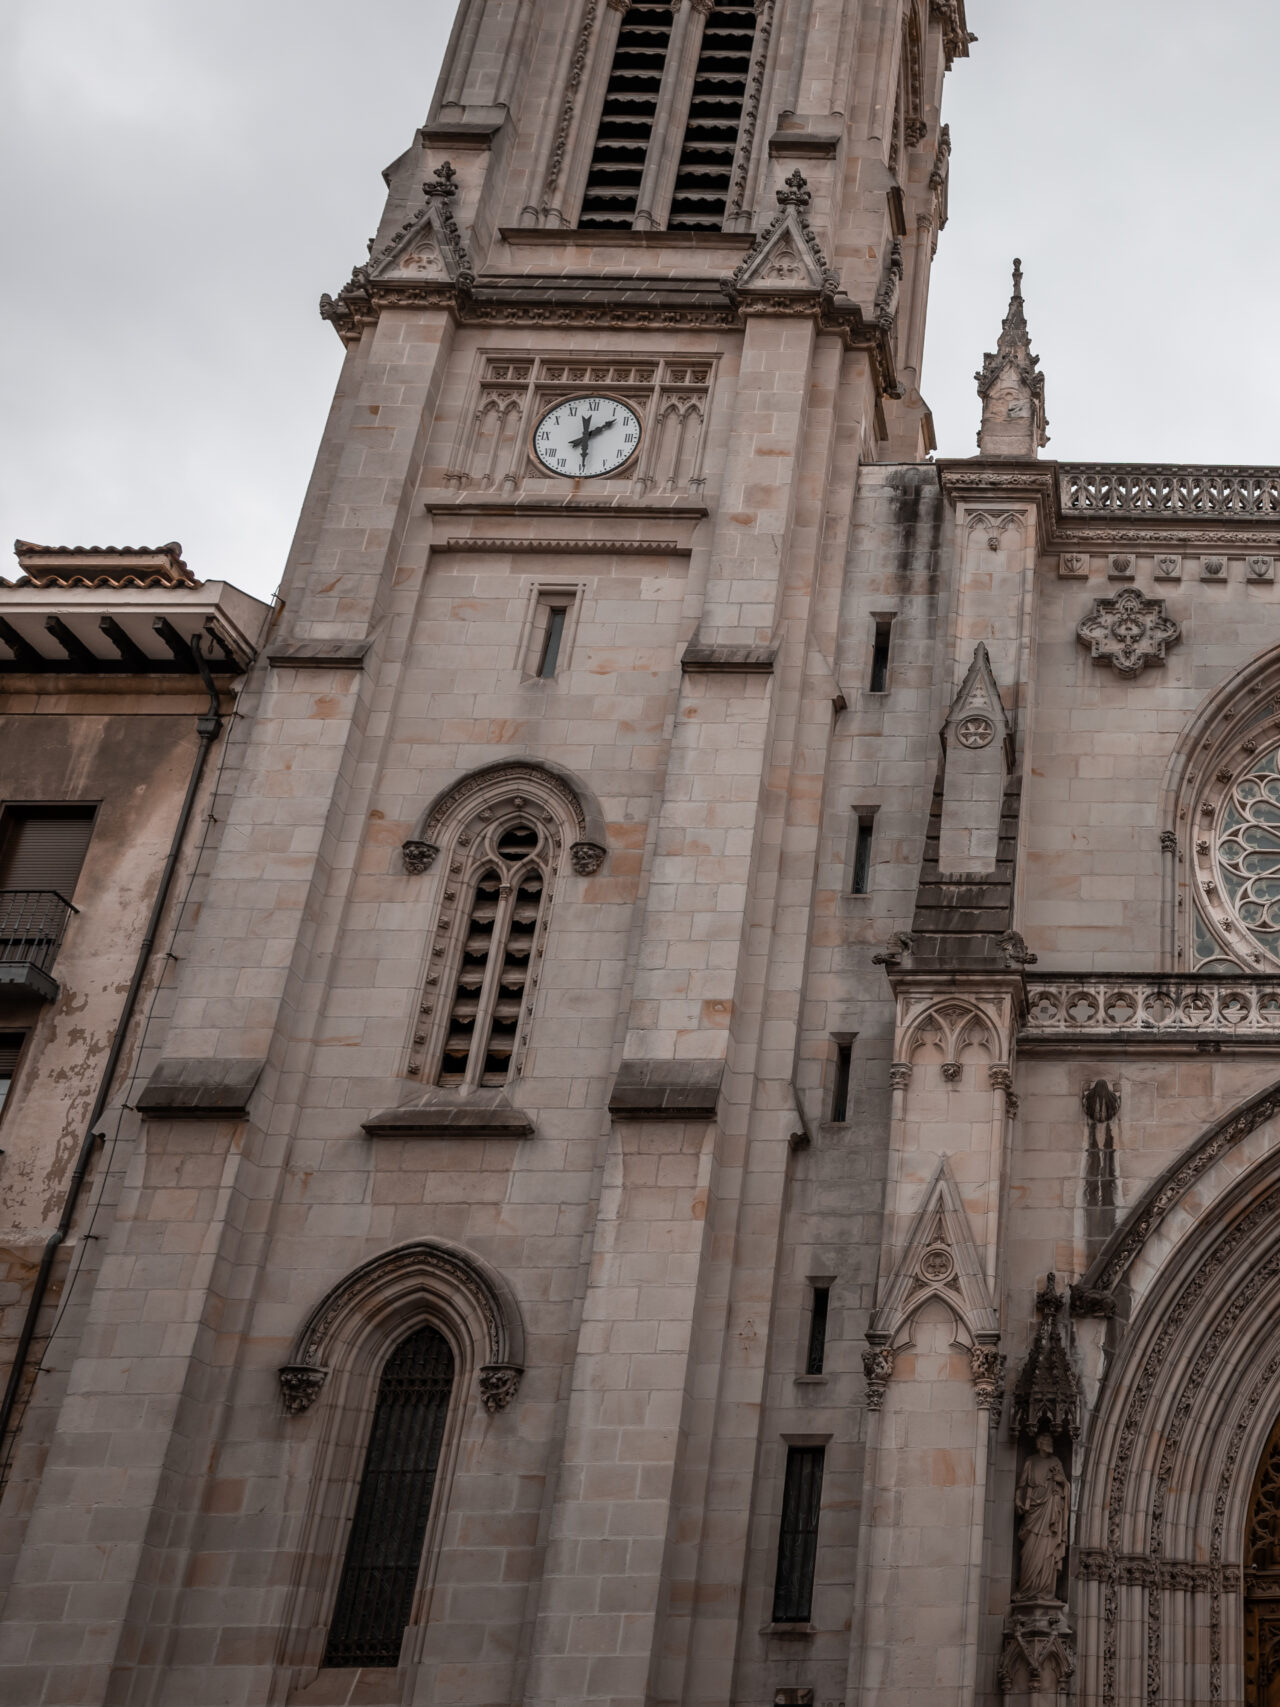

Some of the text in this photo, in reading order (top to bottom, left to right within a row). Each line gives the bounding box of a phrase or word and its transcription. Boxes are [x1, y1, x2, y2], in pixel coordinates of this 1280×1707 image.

[588, 401, 600, 411] XII
[568, 407, 578, 416] XI
[554, 416, 560, 426] X
[622, 416, 629, 426] II
[541, 432, 550, 440] IX
[624, 434, 634, 442] III
[545, 448, 557, 458] VIII
[616, 449, 624, 458] IV
[557, 458, 566, 467] VII
